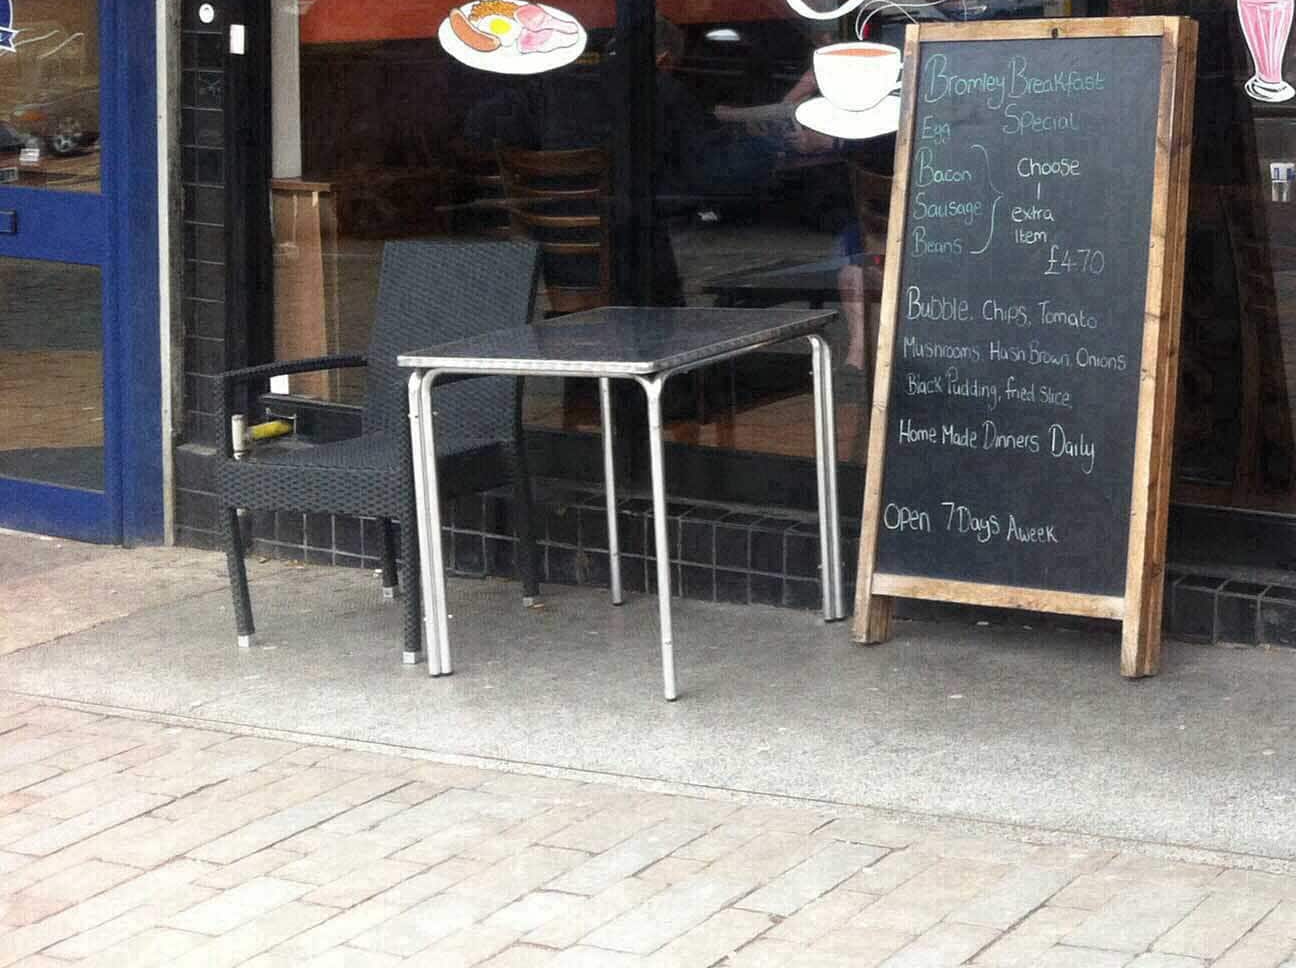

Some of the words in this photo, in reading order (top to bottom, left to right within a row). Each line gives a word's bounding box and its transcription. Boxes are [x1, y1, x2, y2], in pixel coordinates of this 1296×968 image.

[924, 53, 1006, 110] Bromley
[1008, 55, 1105, 98] Breakfast
[1002, 103, 1080, 136] Special
[914, 147, 972, 187] Bacon
[1017, 157, 1081, 178] Choose
[912, 191, 983, 225] Sausage
[1011, 205, 1055, 223] extra
[911, 226, 963, 257] Beans
[1038, 300, 1098, 329] Tomato
[990, 341, 1026, 362] Hash
[1076, 347, 1128, 370] Onions
[907, 372, 943, 397] Black
[899, 419, 937, 445] Home
[941, 422, 978, 449] Made
[981, 419, 1040, 453] Dinners
[1049, 423, 1096, 475] Daily
[884, 502, 932, 532] Open
[955, 505, 1001, 543] Days
